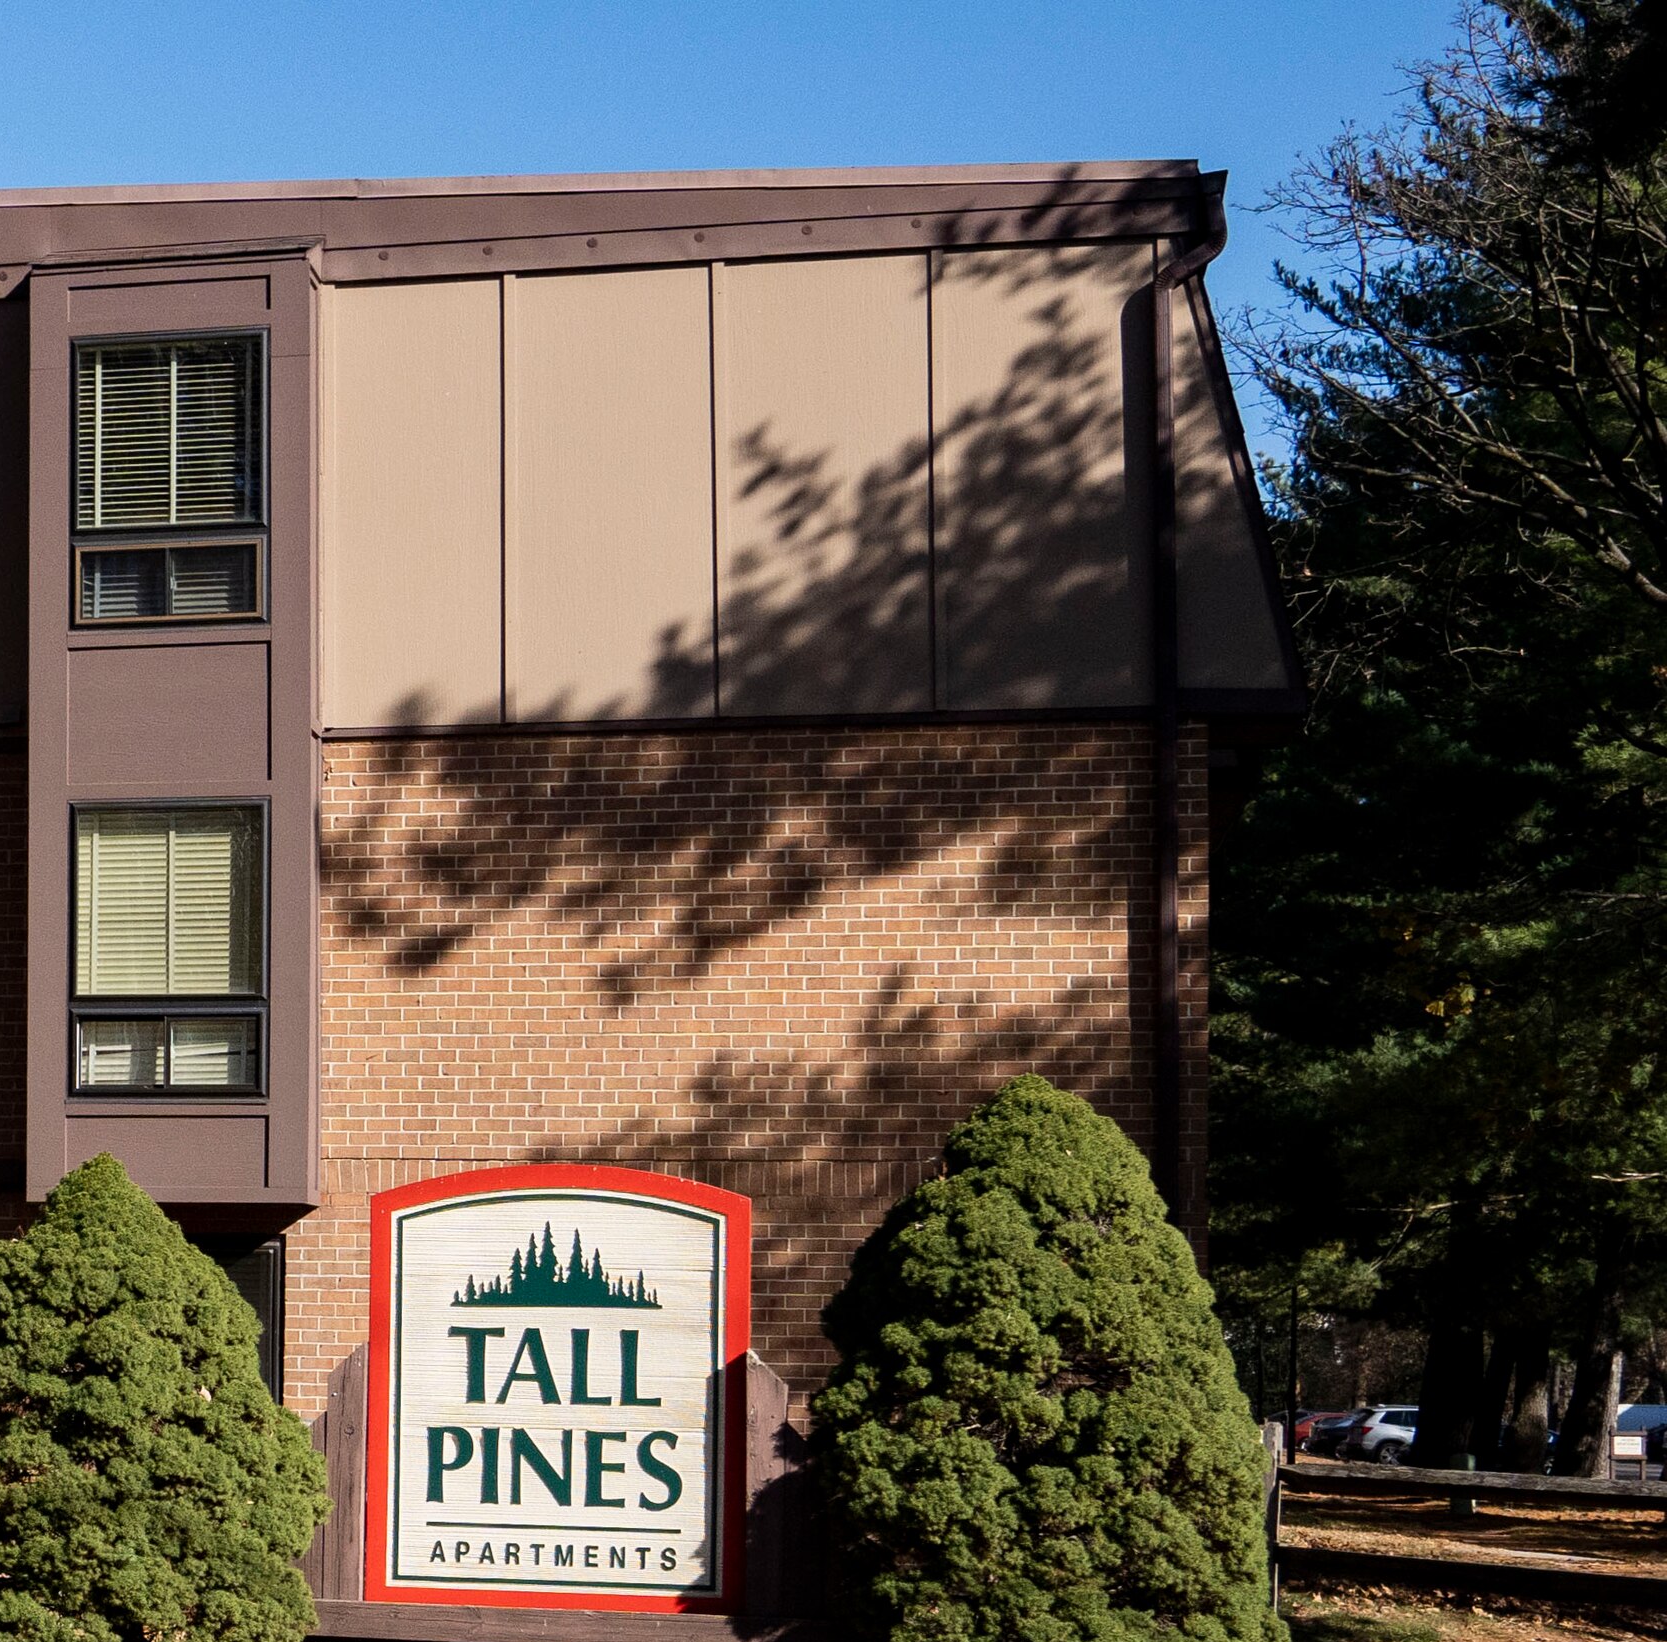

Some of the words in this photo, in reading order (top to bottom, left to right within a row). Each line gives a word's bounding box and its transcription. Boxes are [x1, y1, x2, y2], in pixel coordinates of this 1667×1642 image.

[448, 1325, 662, 1407] TALL
[426, 1426, 683, 1512] PINES
[429, 1540, 678, 1572] APARTMENTS
